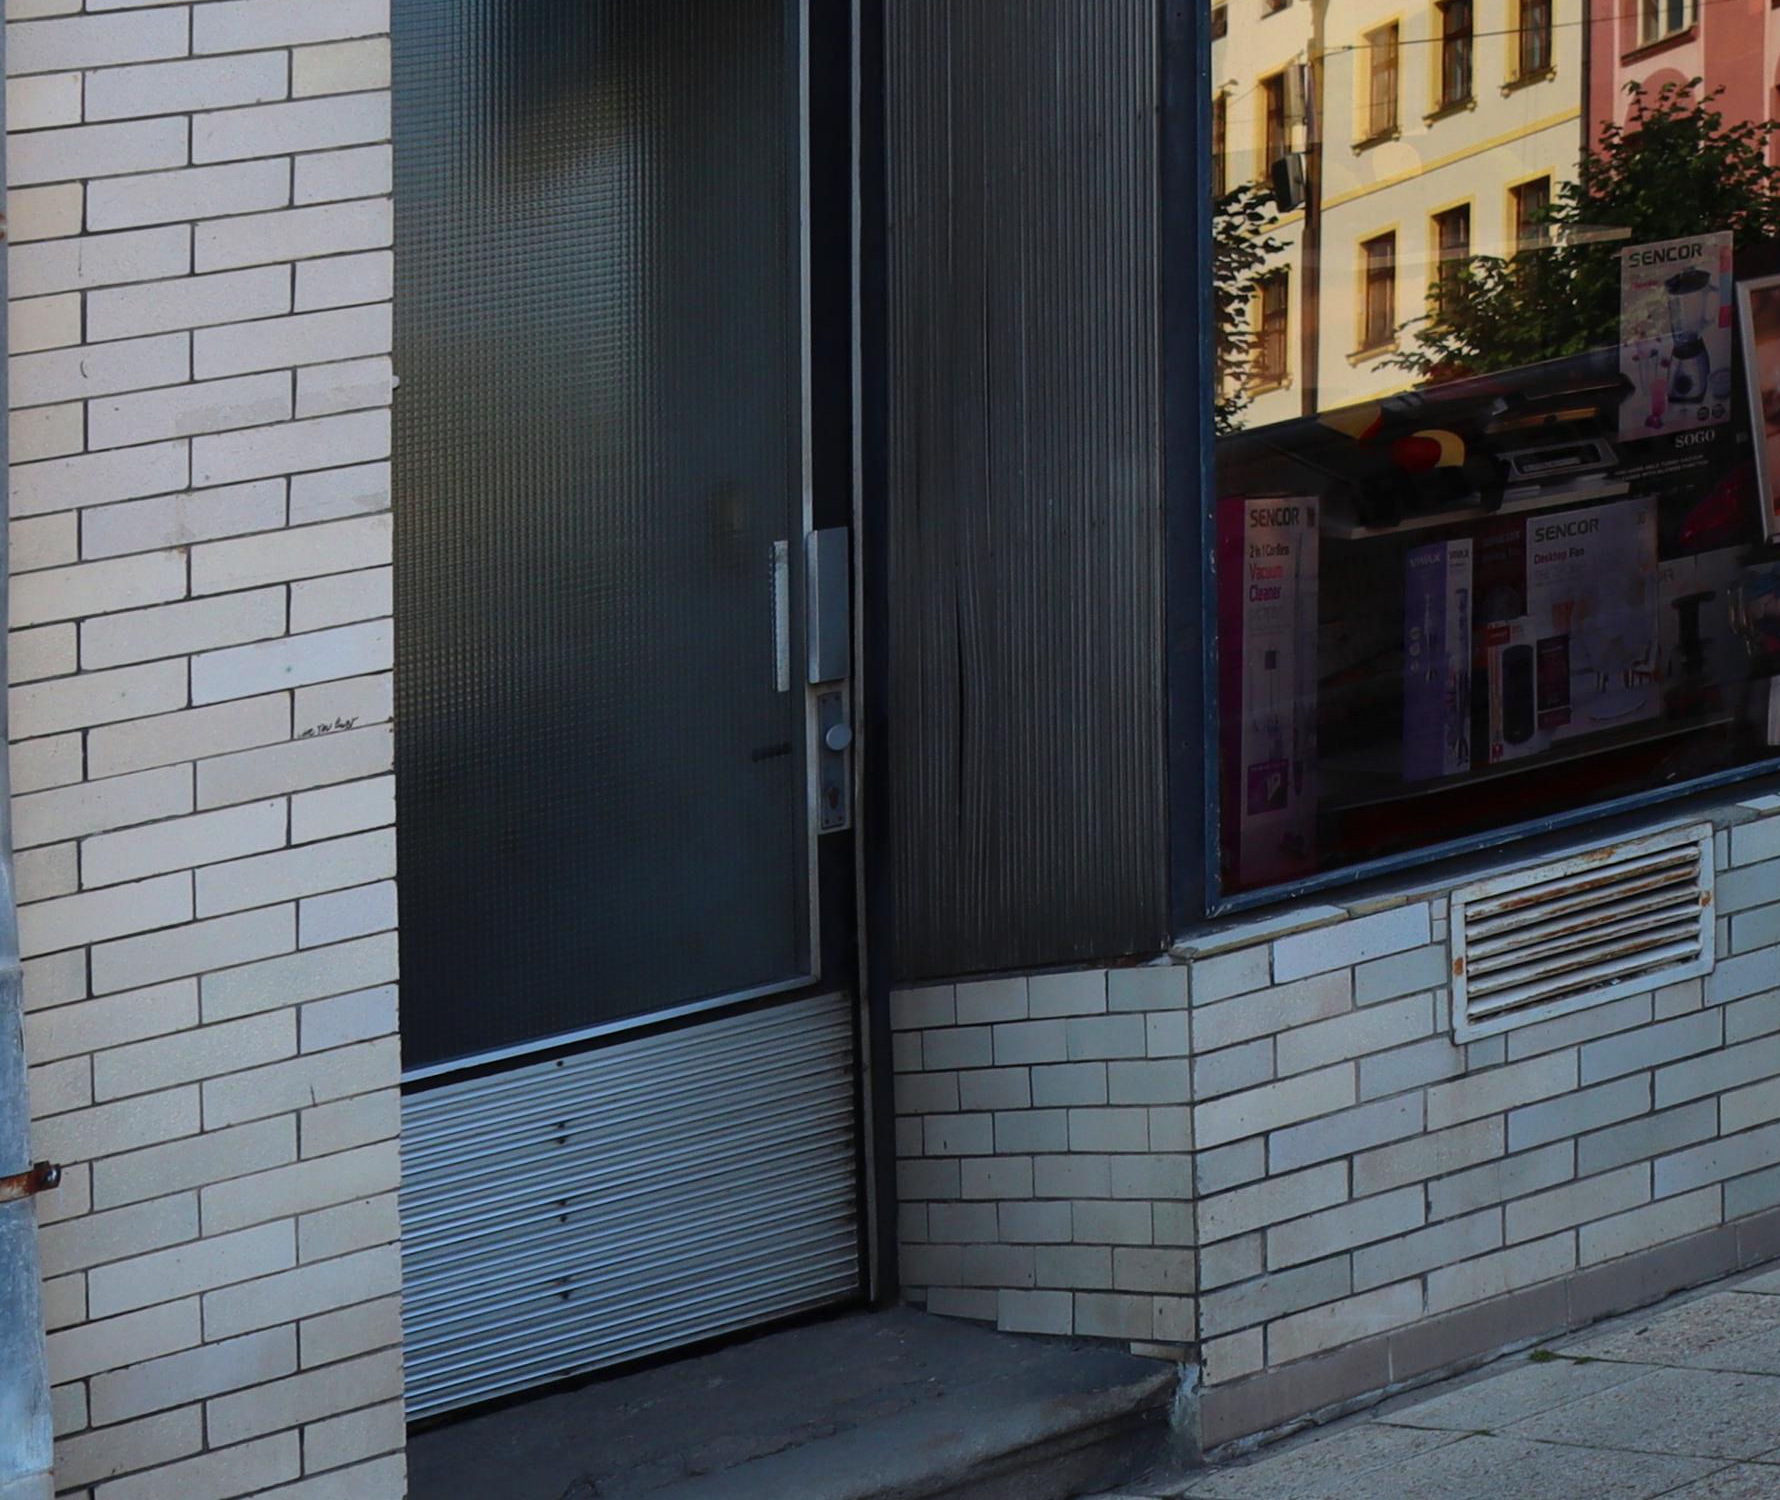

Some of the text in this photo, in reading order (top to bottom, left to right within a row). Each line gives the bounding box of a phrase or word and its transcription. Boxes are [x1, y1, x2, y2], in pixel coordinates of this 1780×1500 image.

[1628, 243, 1703, 268] SENCOR
[1674, 429, 1716, 448] SOGO
[1249, 508, 1300, 528] SENCOR
[1534, 518, 1600, 543] SENCOR
[1533, 547, 1585, 565] Desktop Fan
[1249, 562, 1284, 580] Vacuum
[1249, 584, 1282, 602] Cleaner
